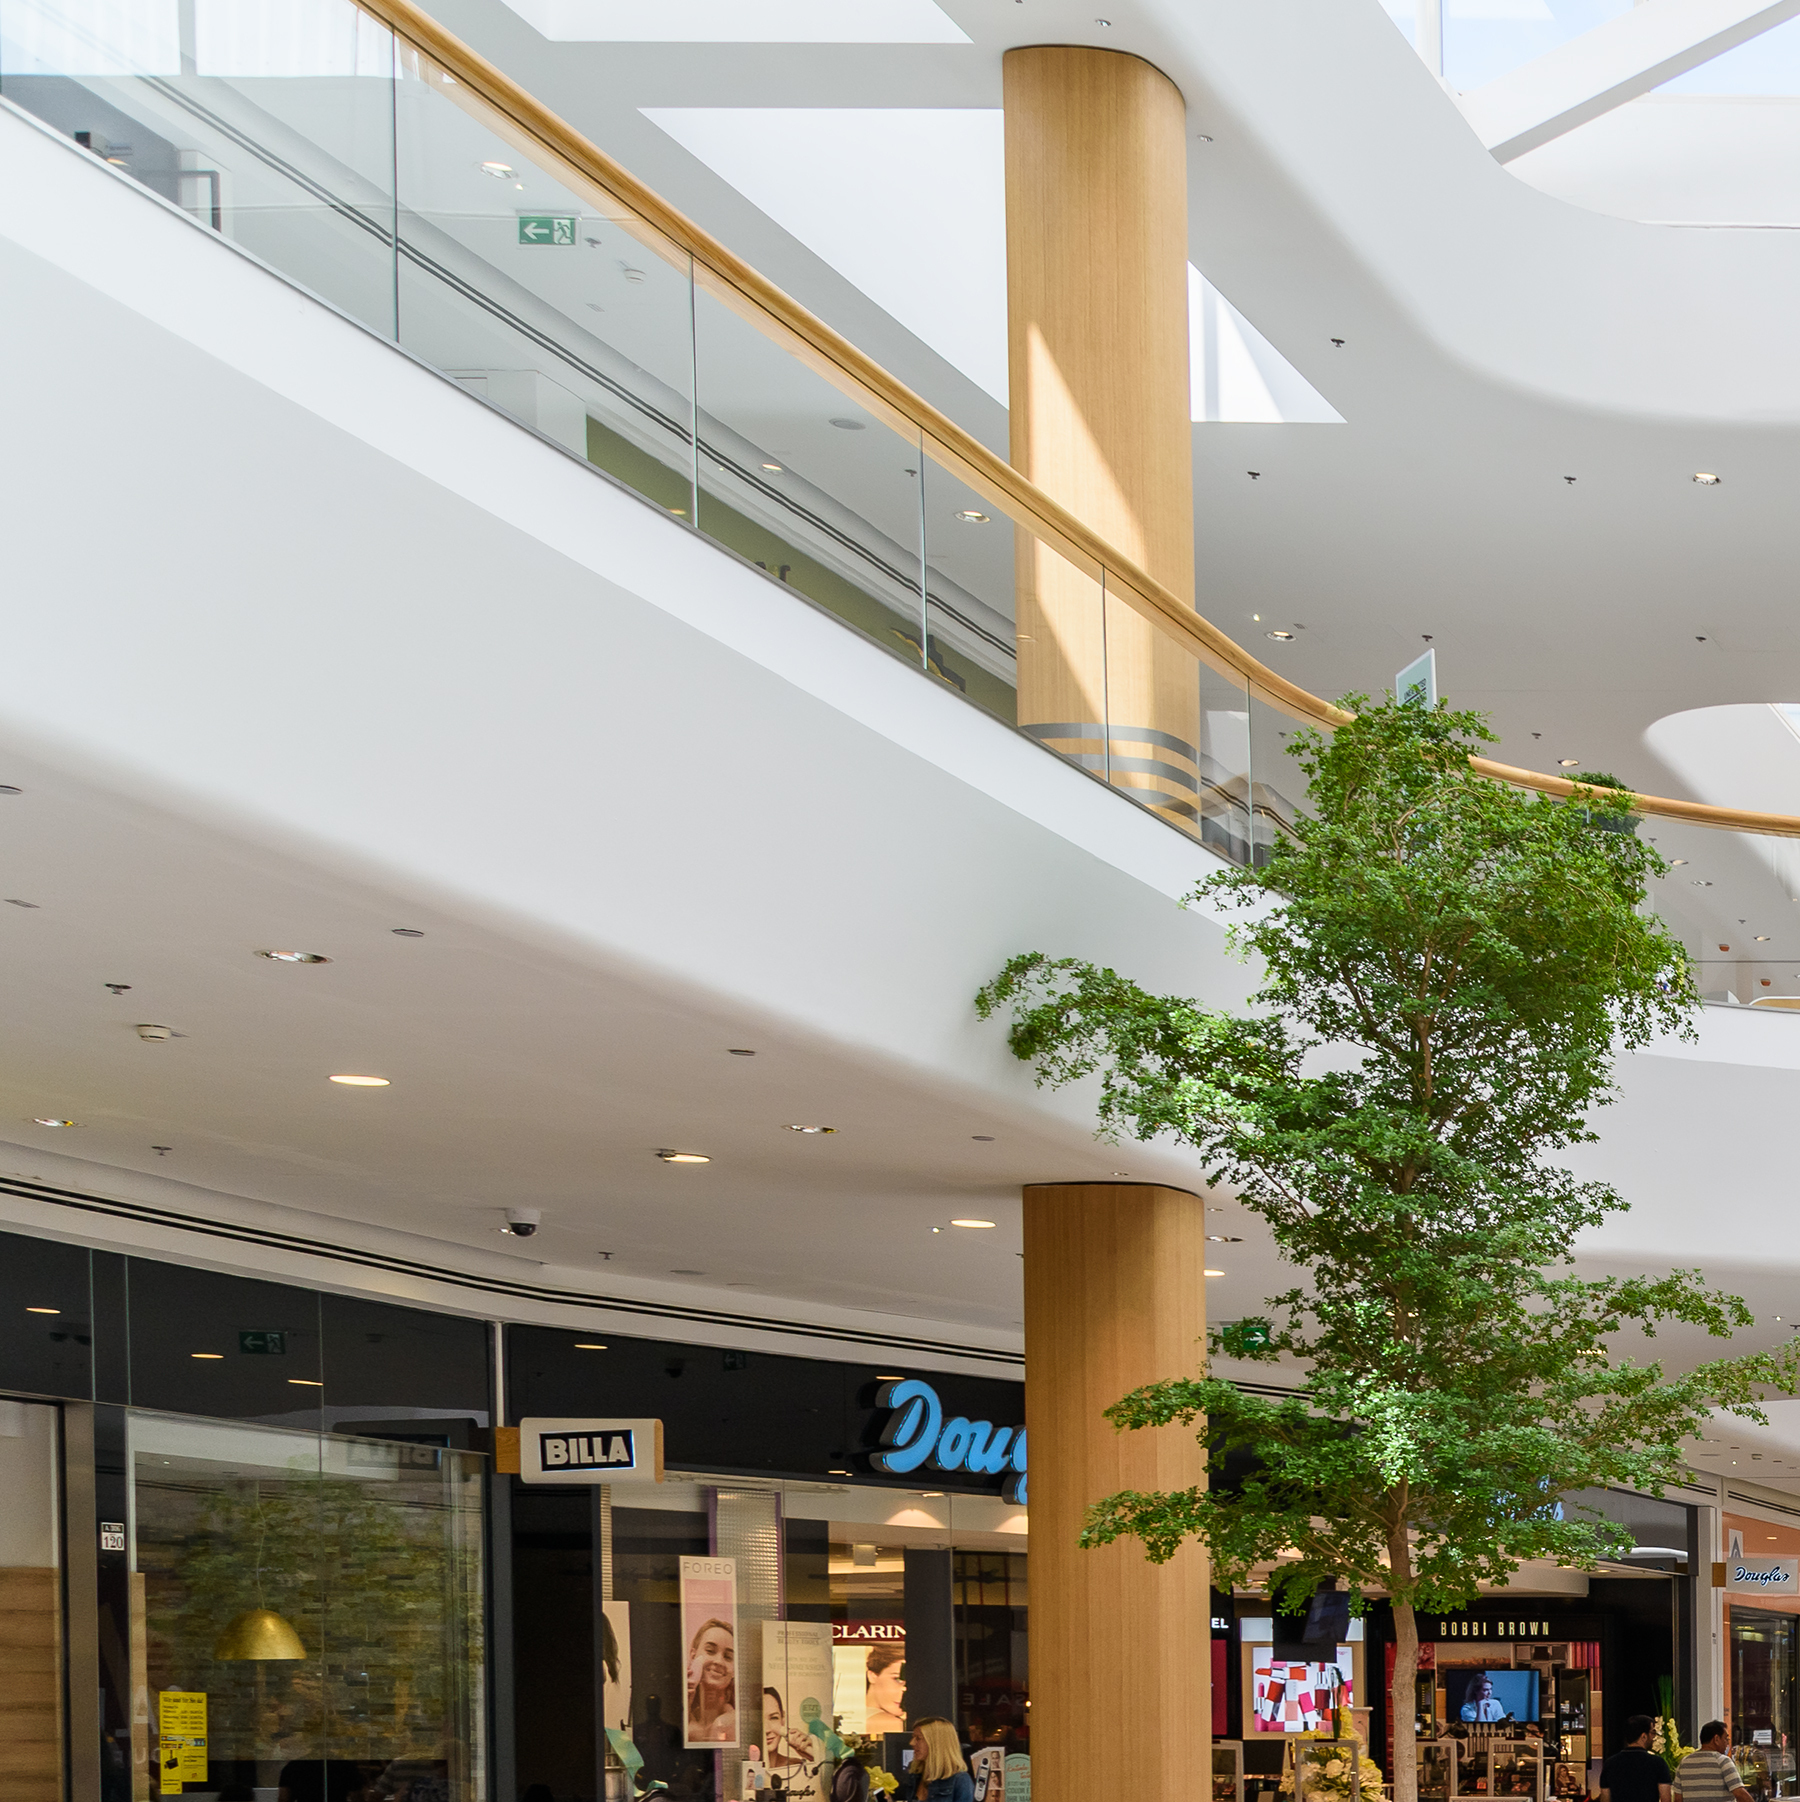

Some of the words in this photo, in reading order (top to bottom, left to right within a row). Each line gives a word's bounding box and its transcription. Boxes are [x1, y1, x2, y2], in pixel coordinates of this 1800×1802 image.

[545, 1436, 630, 1465] BILLA
[103, 1536, 124, 1549] 120
[683, 1561, 733, 1575] FOREO
[1733, 1565, 1790, 1586] Douglas
[1441, 1621, 1487, 1636] BOBBI
[1498, 1621, 1550, 1636] BROWN
